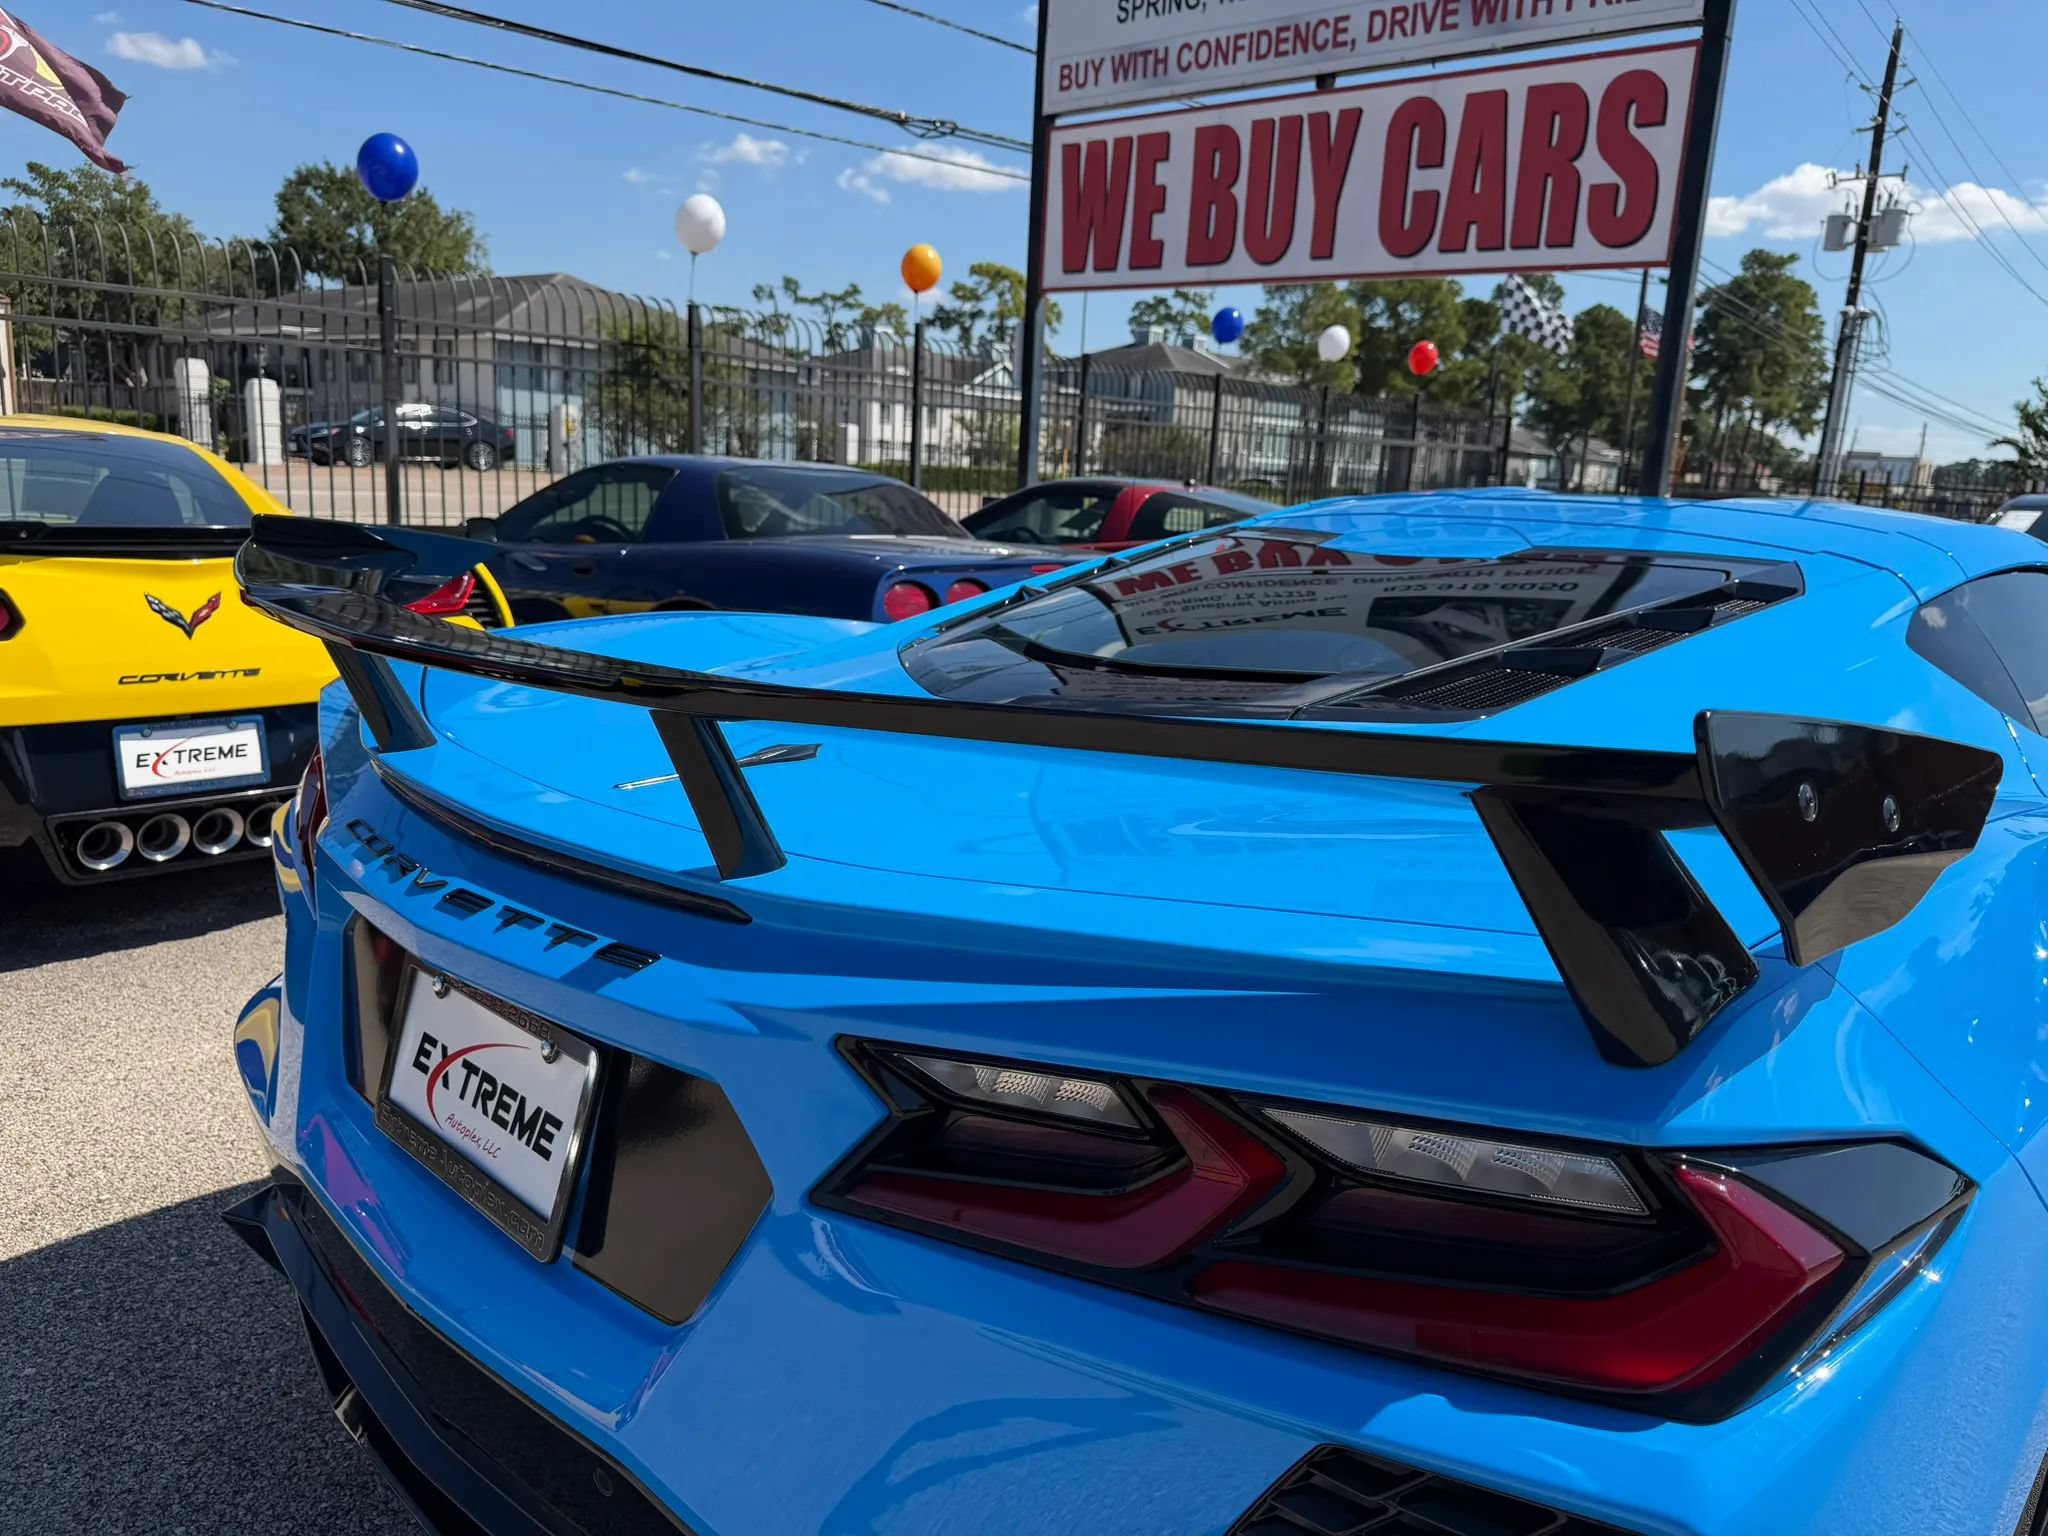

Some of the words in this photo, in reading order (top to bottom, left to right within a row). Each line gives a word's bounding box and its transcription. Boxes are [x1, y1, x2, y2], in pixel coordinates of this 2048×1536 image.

[1059, 57, 1105, 93] BUY
[1111, 46, 1169, 84] WITH
[1176, 14, 1357, 74] CONFIDENCE,
[1367, 0, 1459, 43] DRIVE
[1061, 131, 1170, 275] WE
[1185, 107, 1363, 268] BUY
[1378, 69, 1668, 259] CARS
[135, 743, 250, 770] EXTREME
[345, 819, 664, 971] CORVETTE
[412, 1032, 564, 1162] EXTREME
[445, 1112, 482, 1149] Autoplex,
[483, 1138, 502, 1159] LLC
